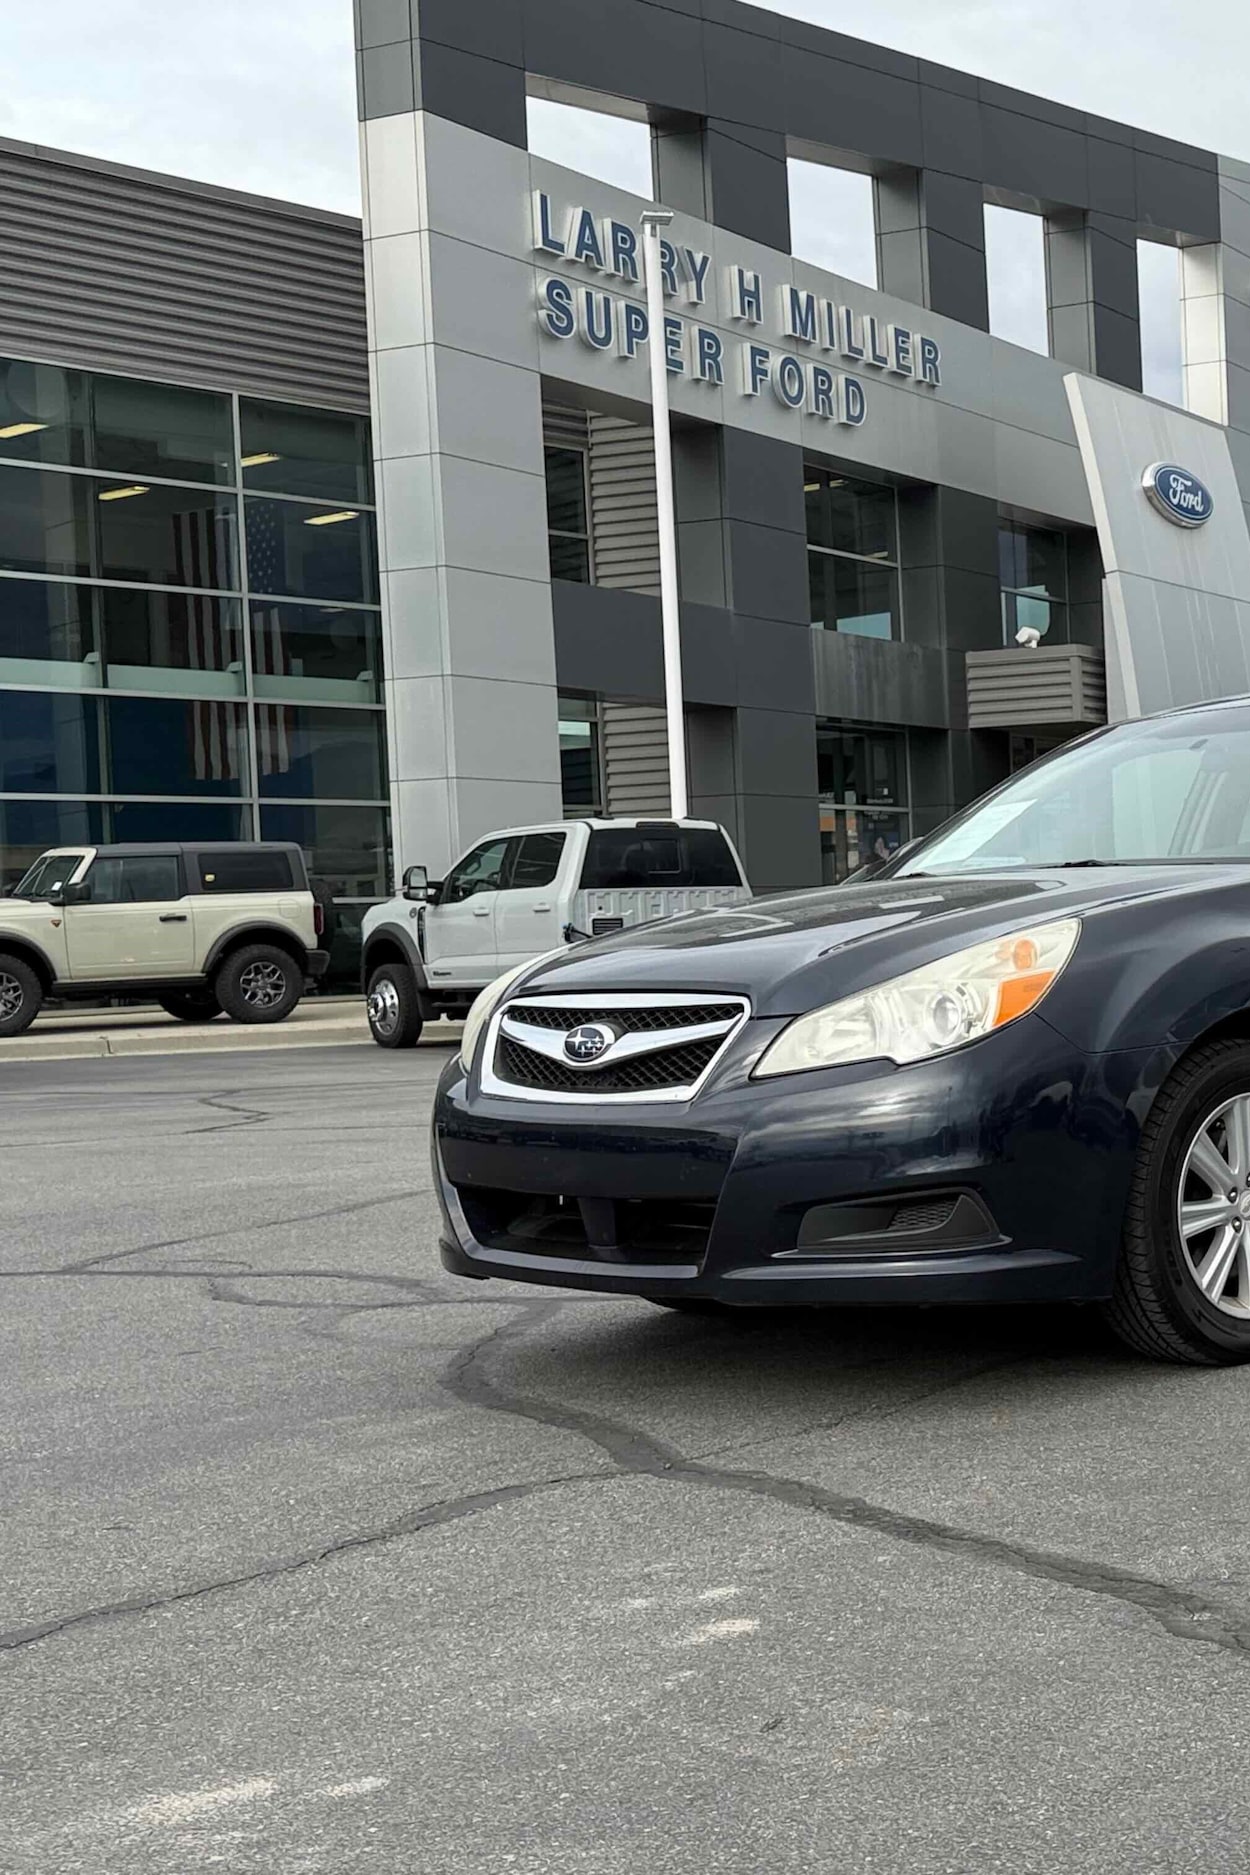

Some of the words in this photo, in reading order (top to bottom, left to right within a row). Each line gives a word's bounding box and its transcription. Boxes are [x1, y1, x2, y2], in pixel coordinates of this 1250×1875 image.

[532, 189, 711, 304] LARRY
[730, 264, 763, 325] H
[781, 284, 942, 387] MILLER
[538, 275, 725, 386] SUPER
[743, 341, 867, 427] FORD
[1168, 474, 1204, 512] Ford
